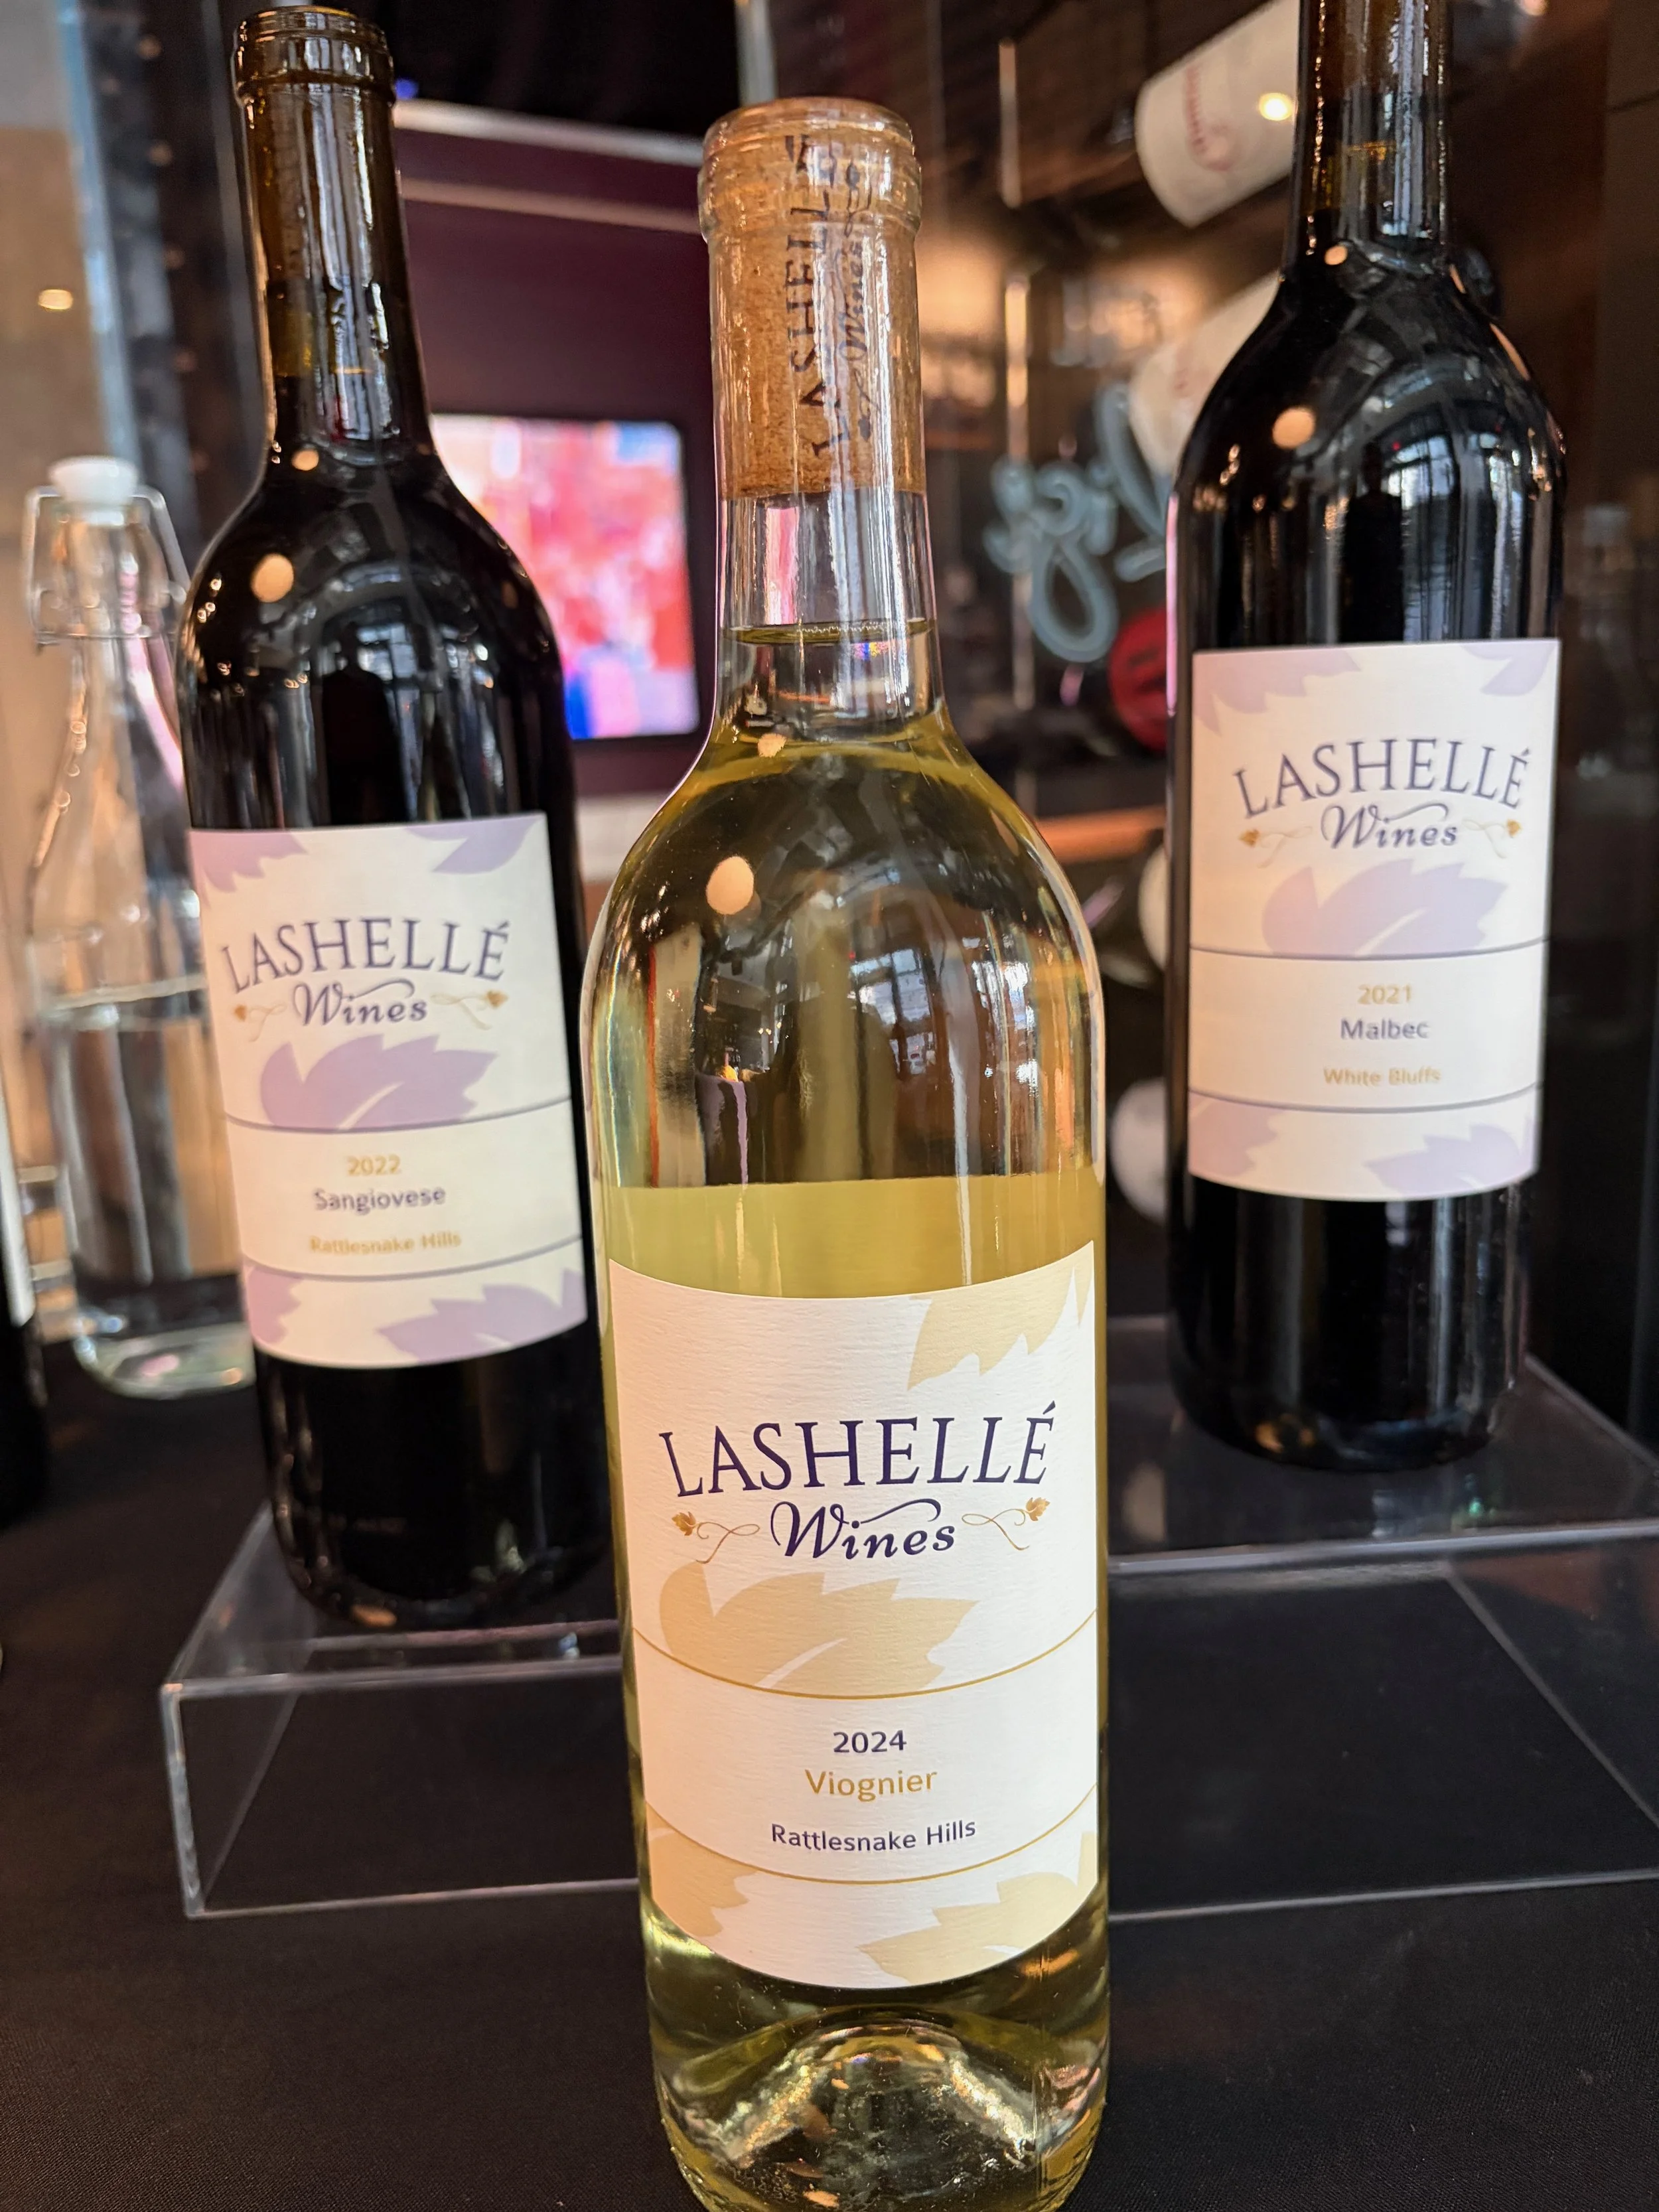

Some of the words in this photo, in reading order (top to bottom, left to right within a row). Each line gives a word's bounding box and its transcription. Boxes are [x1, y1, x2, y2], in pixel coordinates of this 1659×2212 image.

[1232, 735, 1532, 818] LASHELLÉ
[1320, 802, 1458, 850] Wines
[220, 916, 512, 994] LASHELLÉ
[292, 978, 428, 1027] Wines
[1357, 984, 1412, 1005] 2021
[1340, 1018, 1430, 1039] Malbec
[1323, 1068, 1382, 1086] White
[1388, 1066, 1441, 1085] Bluffs
[347, 1155, 401, 1176] 2022
[315, 1187, 446, 1215] Sangiovese
[310, 1236, 415, 1254] Rattlesnake
[421, 1230, 461, 1248] Hills
[659, 1400, 1056, 1497] LASHELLÉ
[770, 1498, 956, 1560] Wines
[833, 1730, 907, 1754] 2024
[804, 1768, 938, 1803] Viognier
[770, 1823, 916, 1852] Rattlesnake
[926, 1819, 976, 1846] Hills
